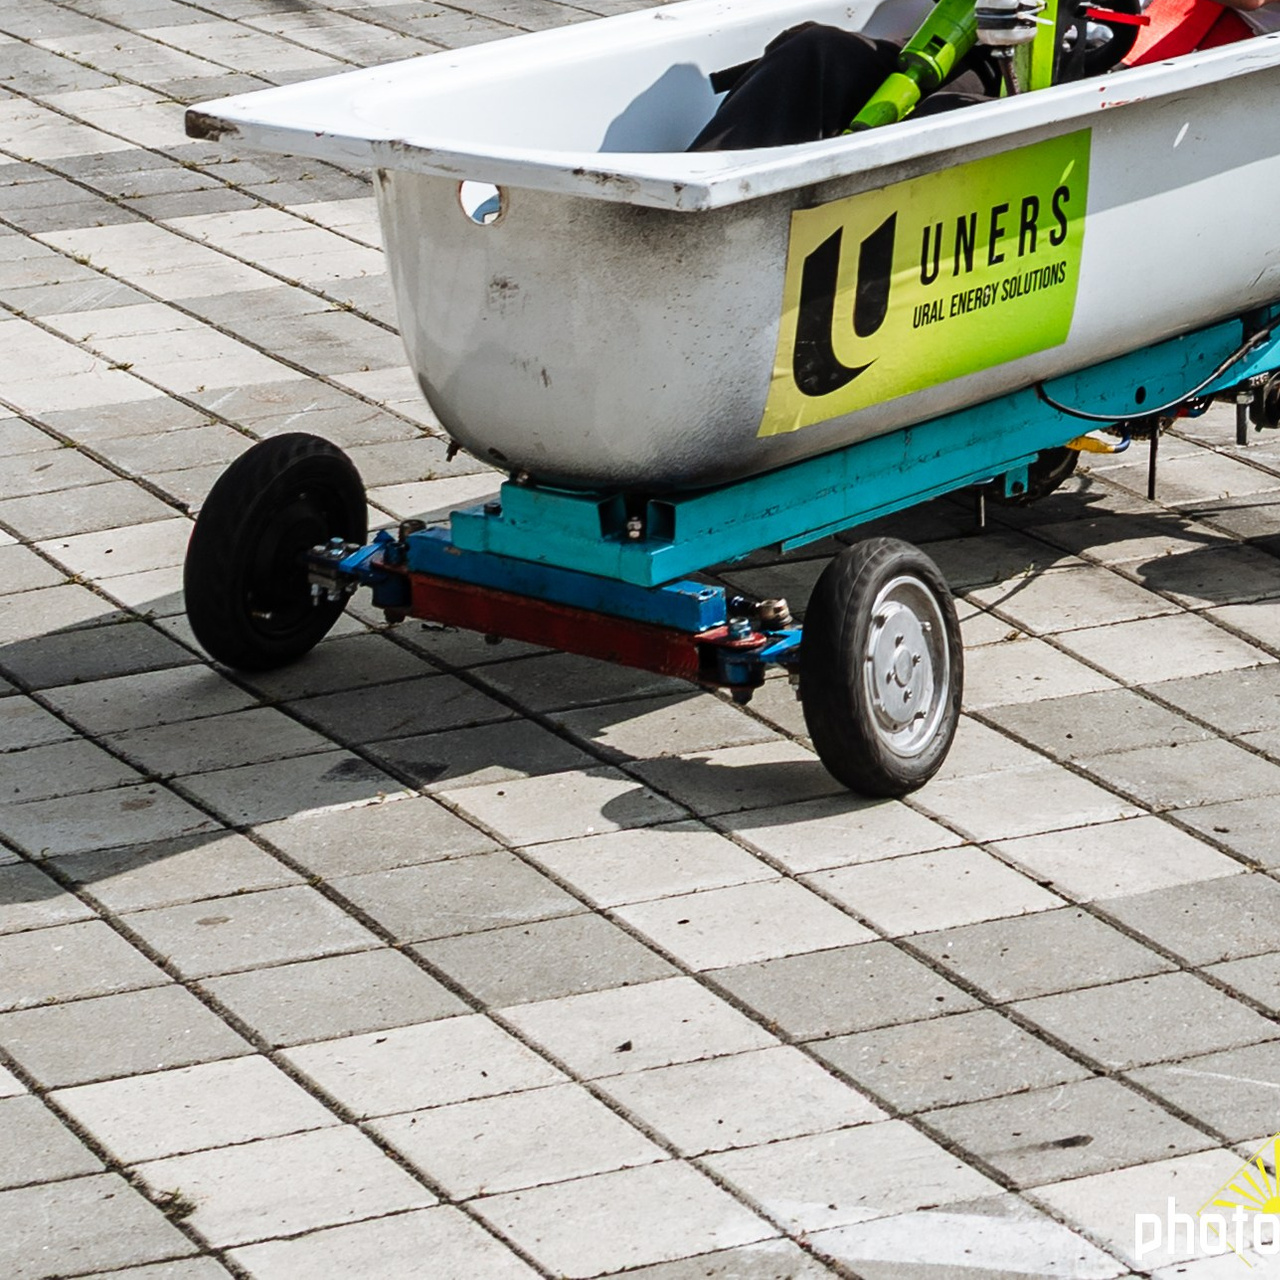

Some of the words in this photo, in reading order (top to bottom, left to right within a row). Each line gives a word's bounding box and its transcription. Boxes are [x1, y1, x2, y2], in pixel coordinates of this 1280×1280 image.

[920, 185, 1071, 286] UNERS
[913, 299, 945, 329] URAL
[949, 285, 999, 318] ENERGY
[1001, 261, 1067, 302] SOLUTIONS
